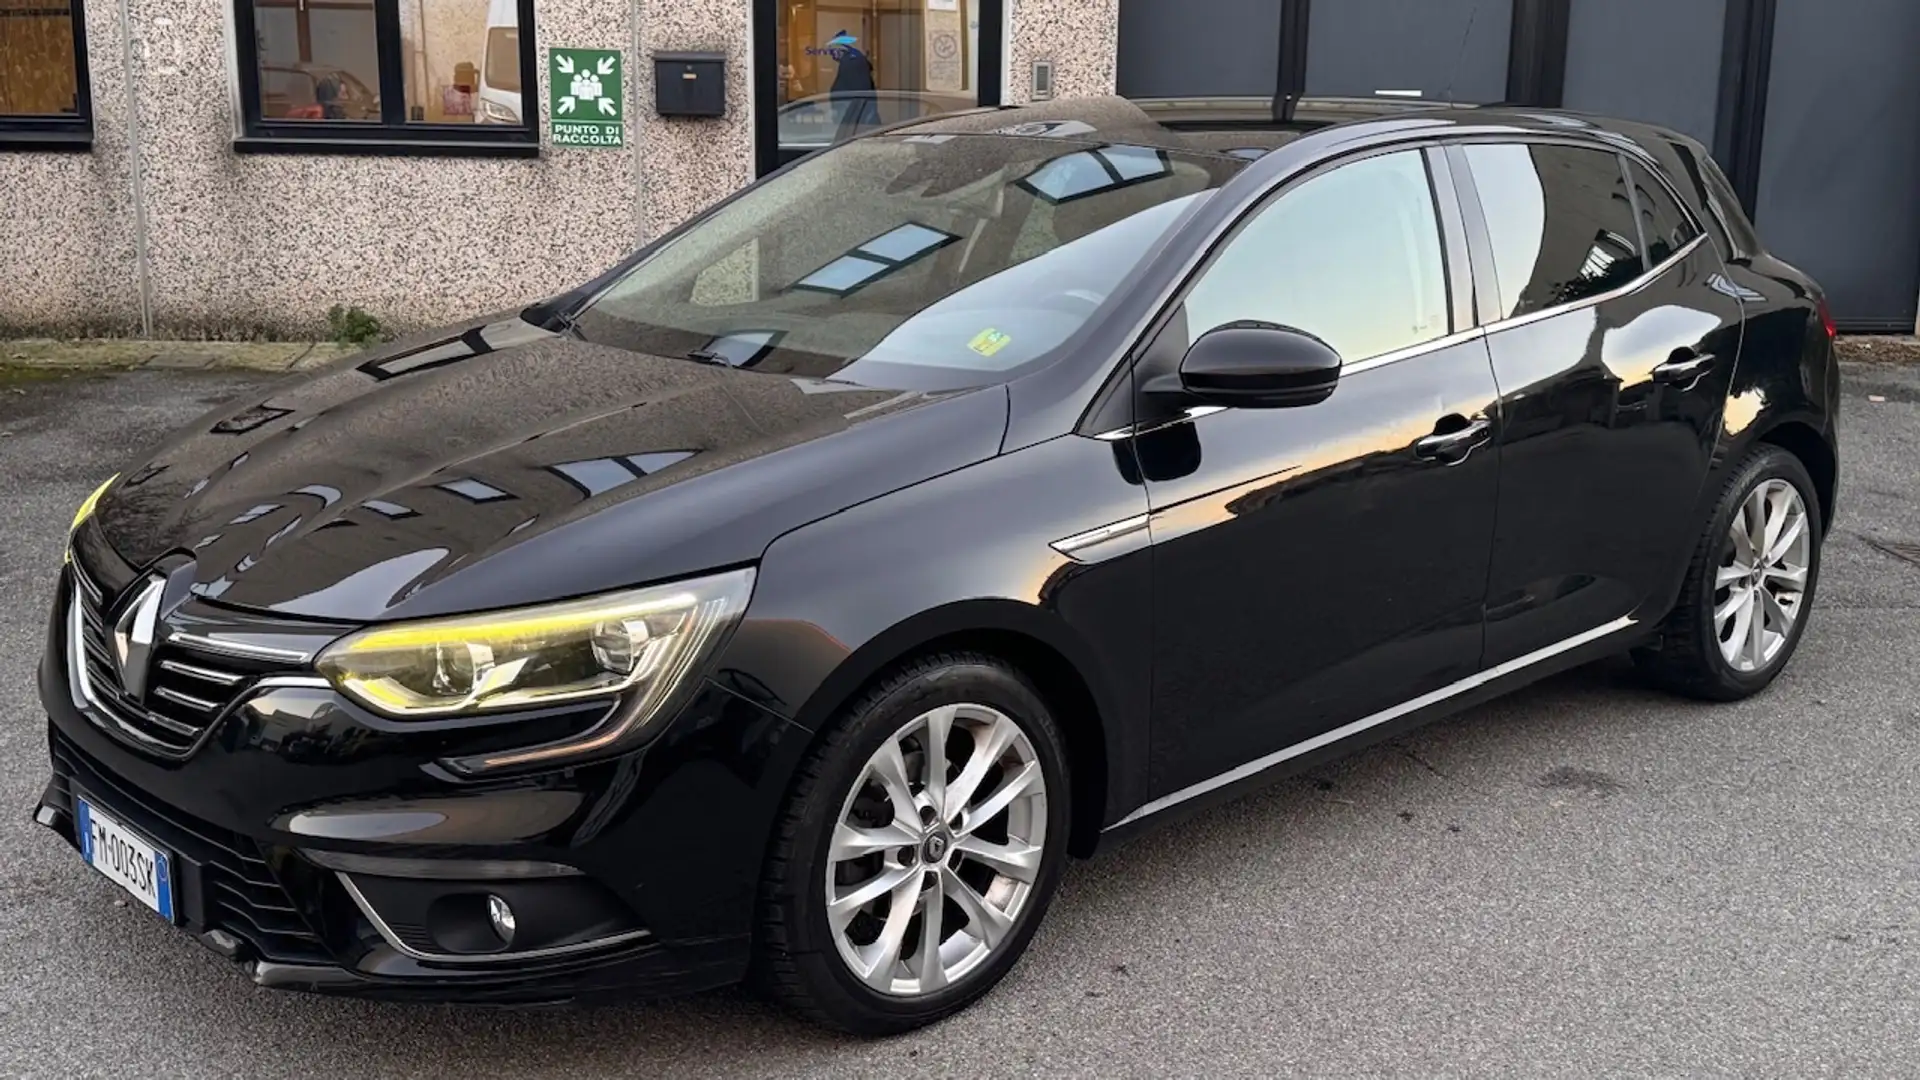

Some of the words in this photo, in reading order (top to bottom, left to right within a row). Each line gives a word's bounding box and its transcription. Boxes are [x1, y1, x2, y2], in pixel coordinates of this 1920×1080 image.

[554, 124, 600, 135] PUNTO
[605, 126, 620, 135] DI
[553, 133, 622, 145] RACCOLTA
